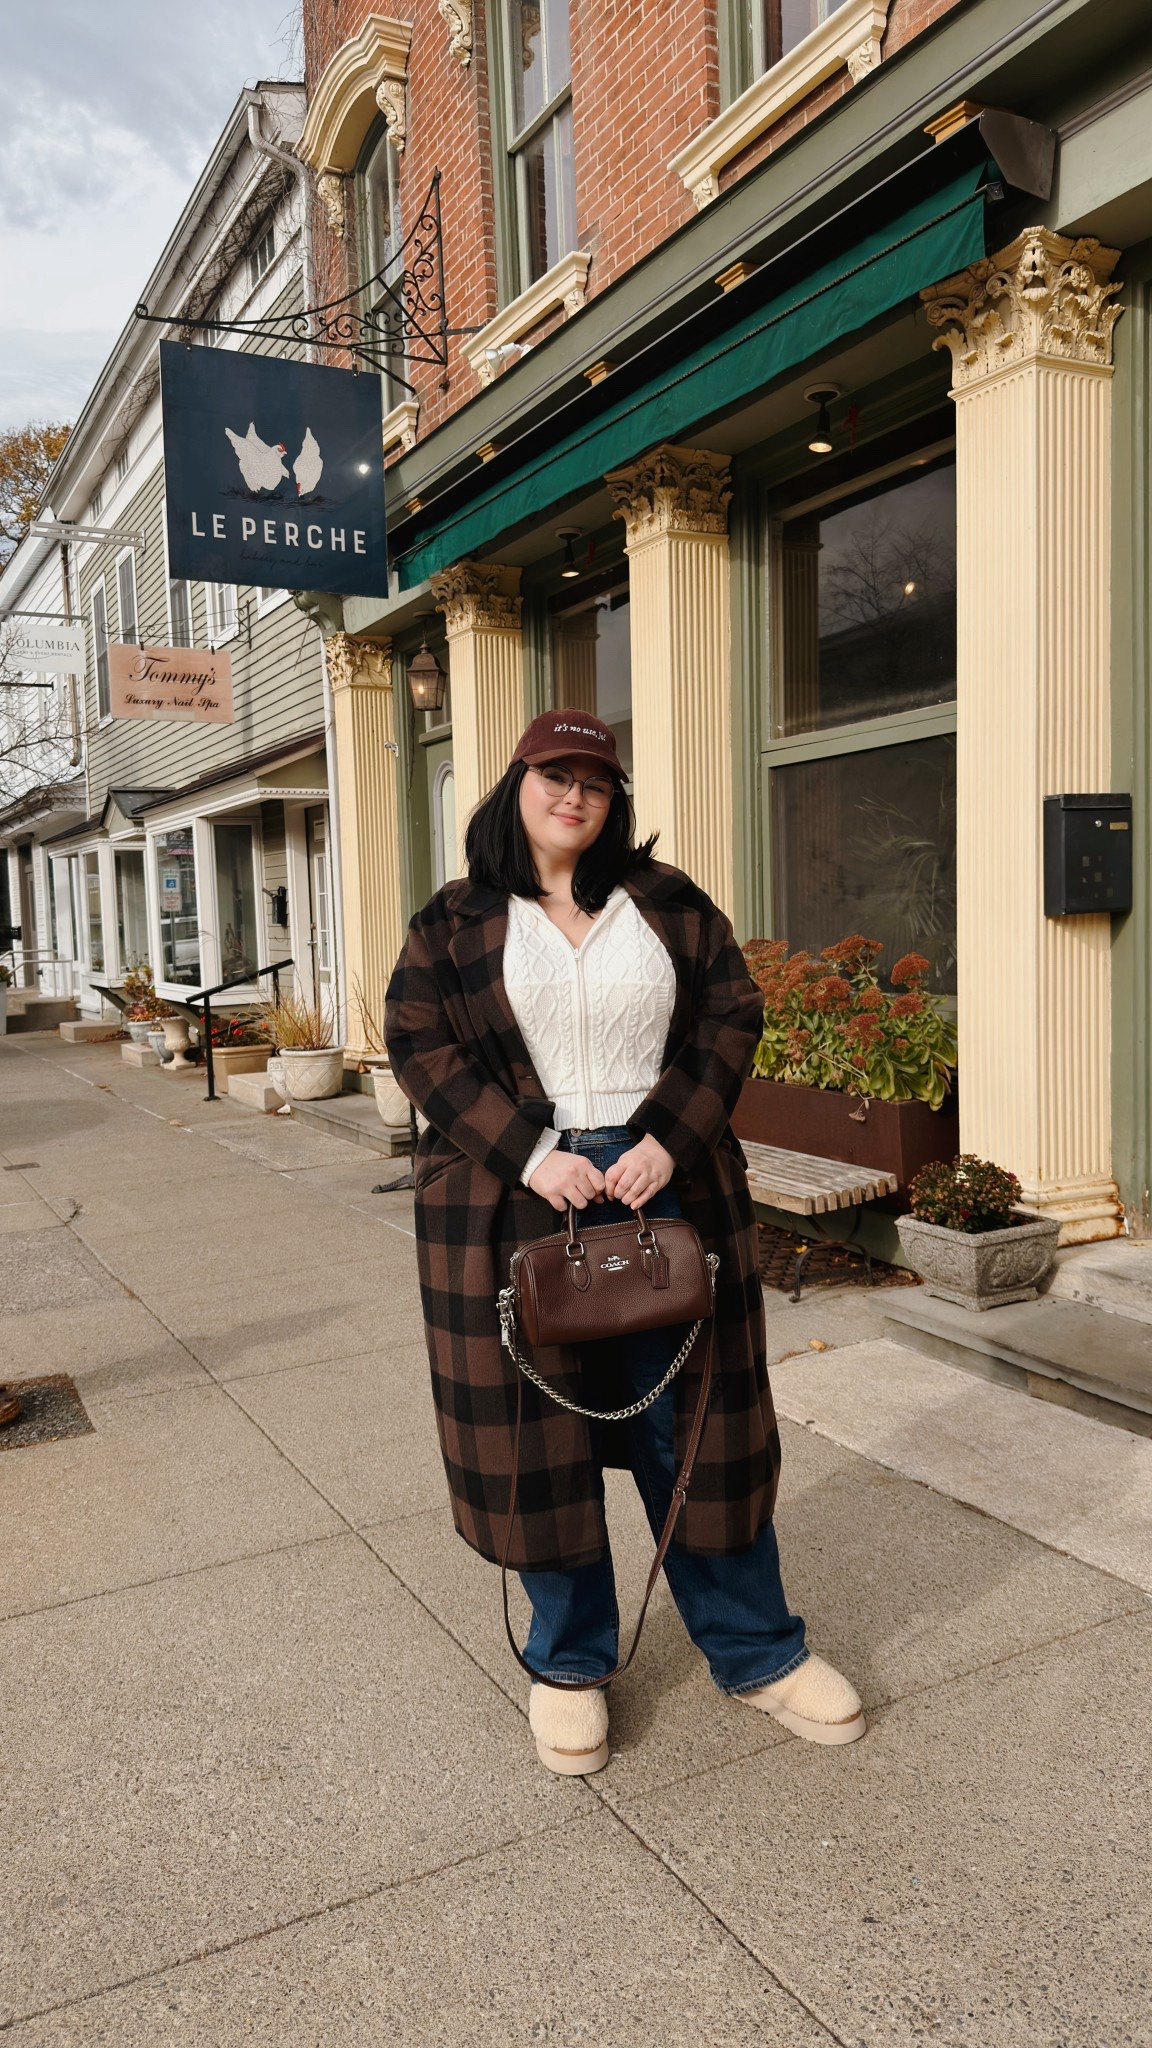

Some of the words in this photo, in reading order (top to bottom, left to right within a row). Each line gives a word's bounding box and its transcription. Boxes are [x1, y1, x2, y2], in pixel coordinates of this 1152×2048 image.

[191, 511, 227, 539] LE
[241, 517, 367, 554] PERCHE
[6, 637, 80, 651] COLUMBIA
[129, 655, 217, 696] Tommy's
[124, 694, 163, 709] Luxury
[167, 697, 194, 707] Nail
[198, 698, 220, 711] Spa
[554, 723, 569, 732] it's
[600, 1260, 629, 1269] COACH
